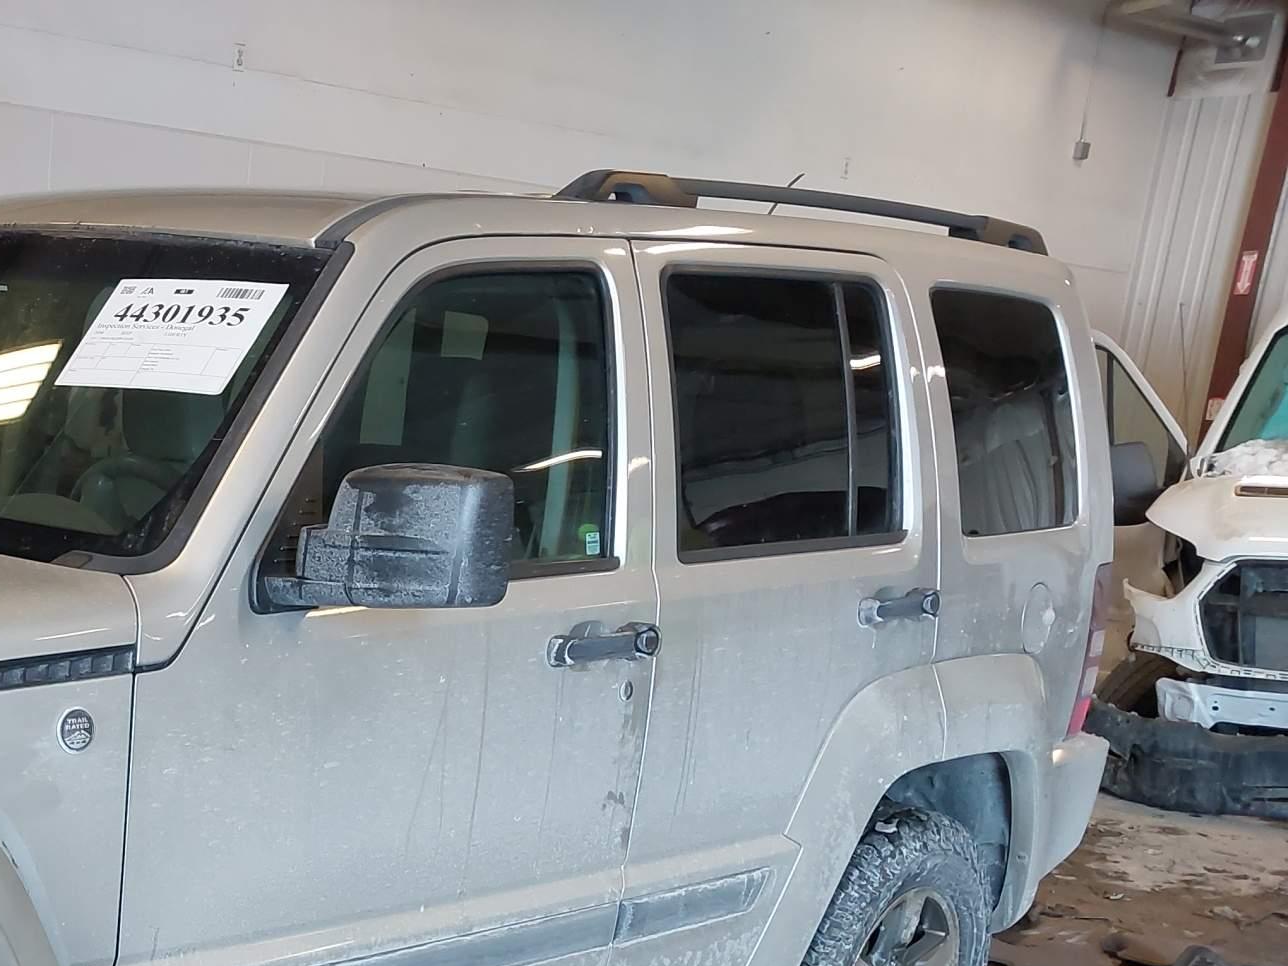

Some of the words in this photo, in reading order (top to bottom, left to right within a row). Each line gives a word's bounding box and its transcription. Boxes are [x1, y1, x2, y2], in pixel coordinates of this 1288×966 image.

[114, 303, 251, 327] 44301935
[66, 717, 89, 725] TRAIL
[65, 723, 90, 731] RATED
